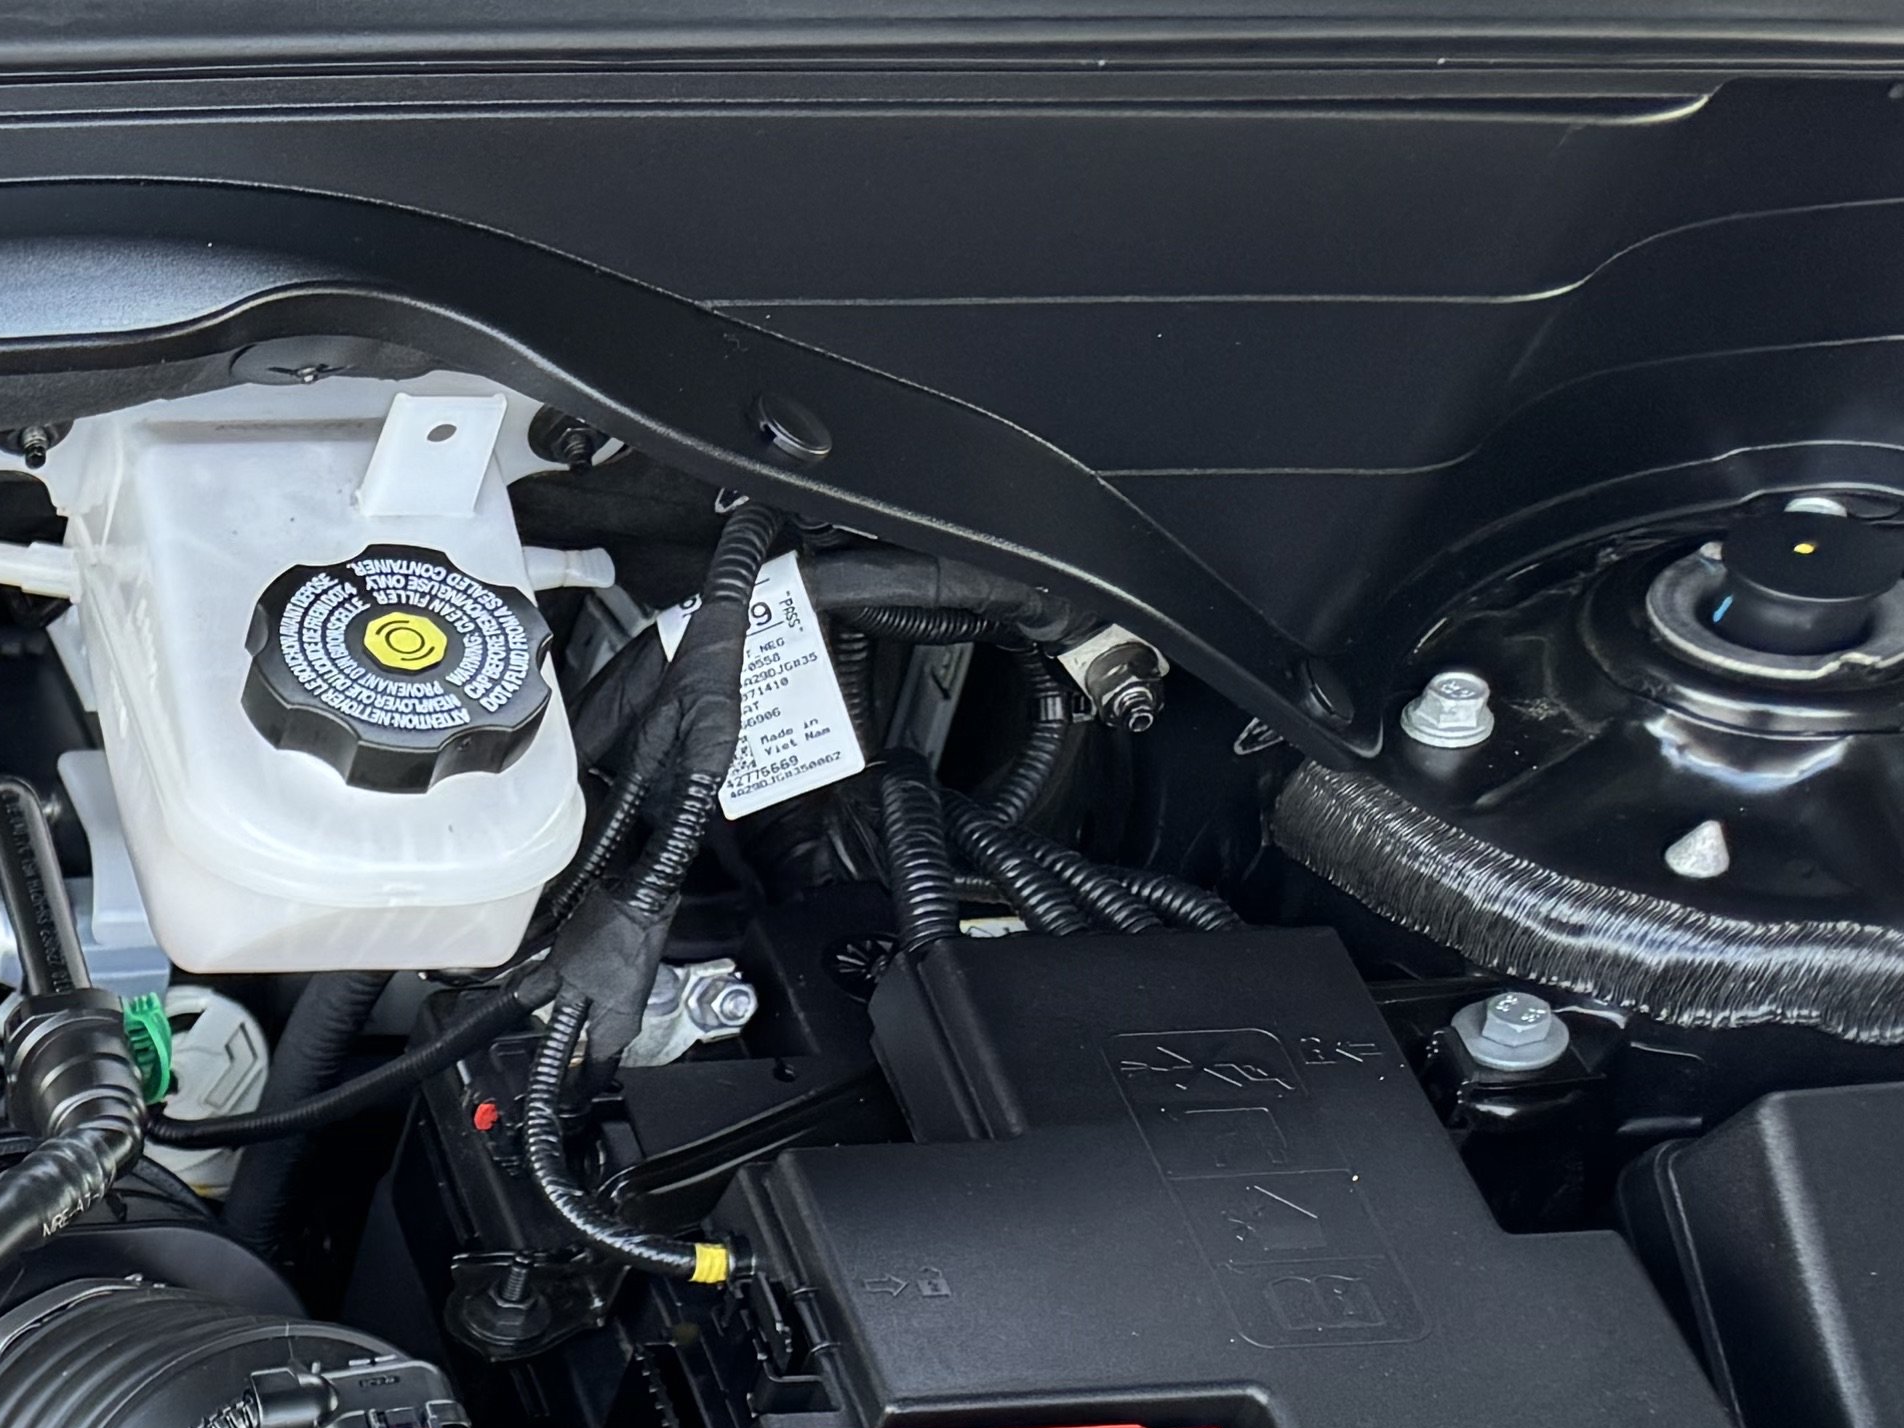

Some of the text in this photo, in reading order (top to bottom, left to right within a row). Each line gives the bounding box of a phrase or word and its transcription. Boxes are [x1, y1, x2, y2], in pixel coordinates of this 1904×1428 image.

[358, 574, 405, 591] ONLY
[405, 574, 441, 595] USE
[442, 569, 506, 611] SEALED
[370, 589, 432, 609] FILLER
[426, 596, 477, 633] CLEAN
[478, 633, 506, 680] BEFORE
[459, 672, 498, 701] CAP
[315, 686, 392, 727] NETTOYER
[760, 718, 819, 746] Made in
